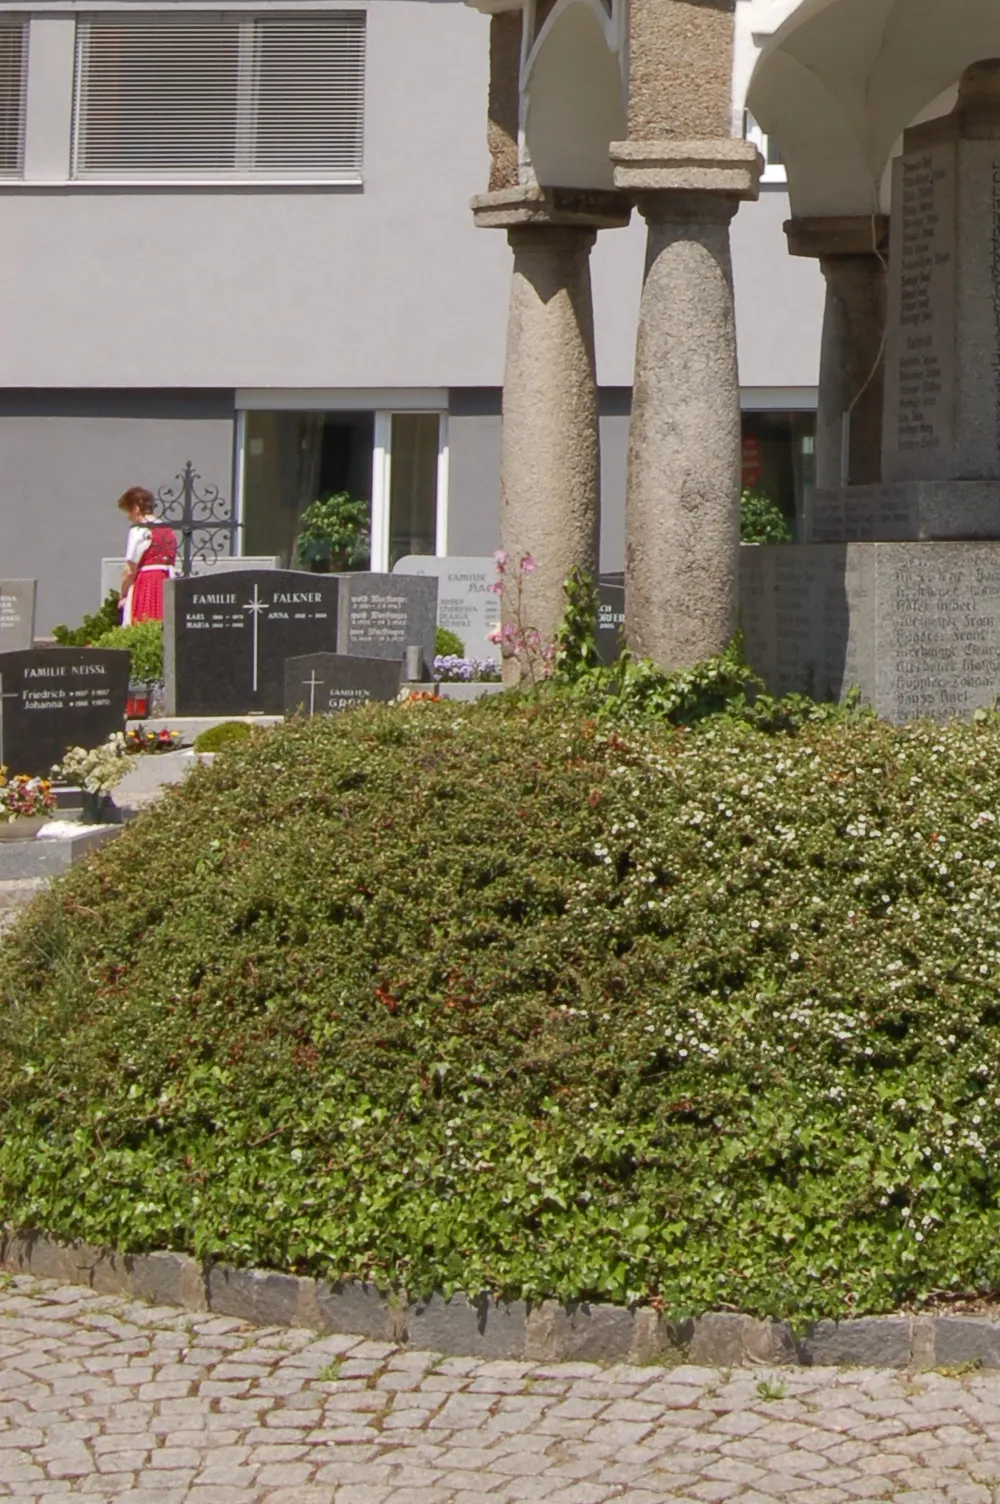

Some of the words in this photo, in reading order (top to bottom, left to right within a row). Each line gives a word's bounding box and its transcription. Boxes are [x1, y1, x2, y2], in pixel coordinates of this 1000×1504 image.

[193, 594, 237, 604] FAMILIE
[273, 592, 322, 604] FALKNER
[24, 667, 66, 678] FAMILIE
[23, 689, 67, 700] Friedrich
[24, 699, 64, 710] Johanna
